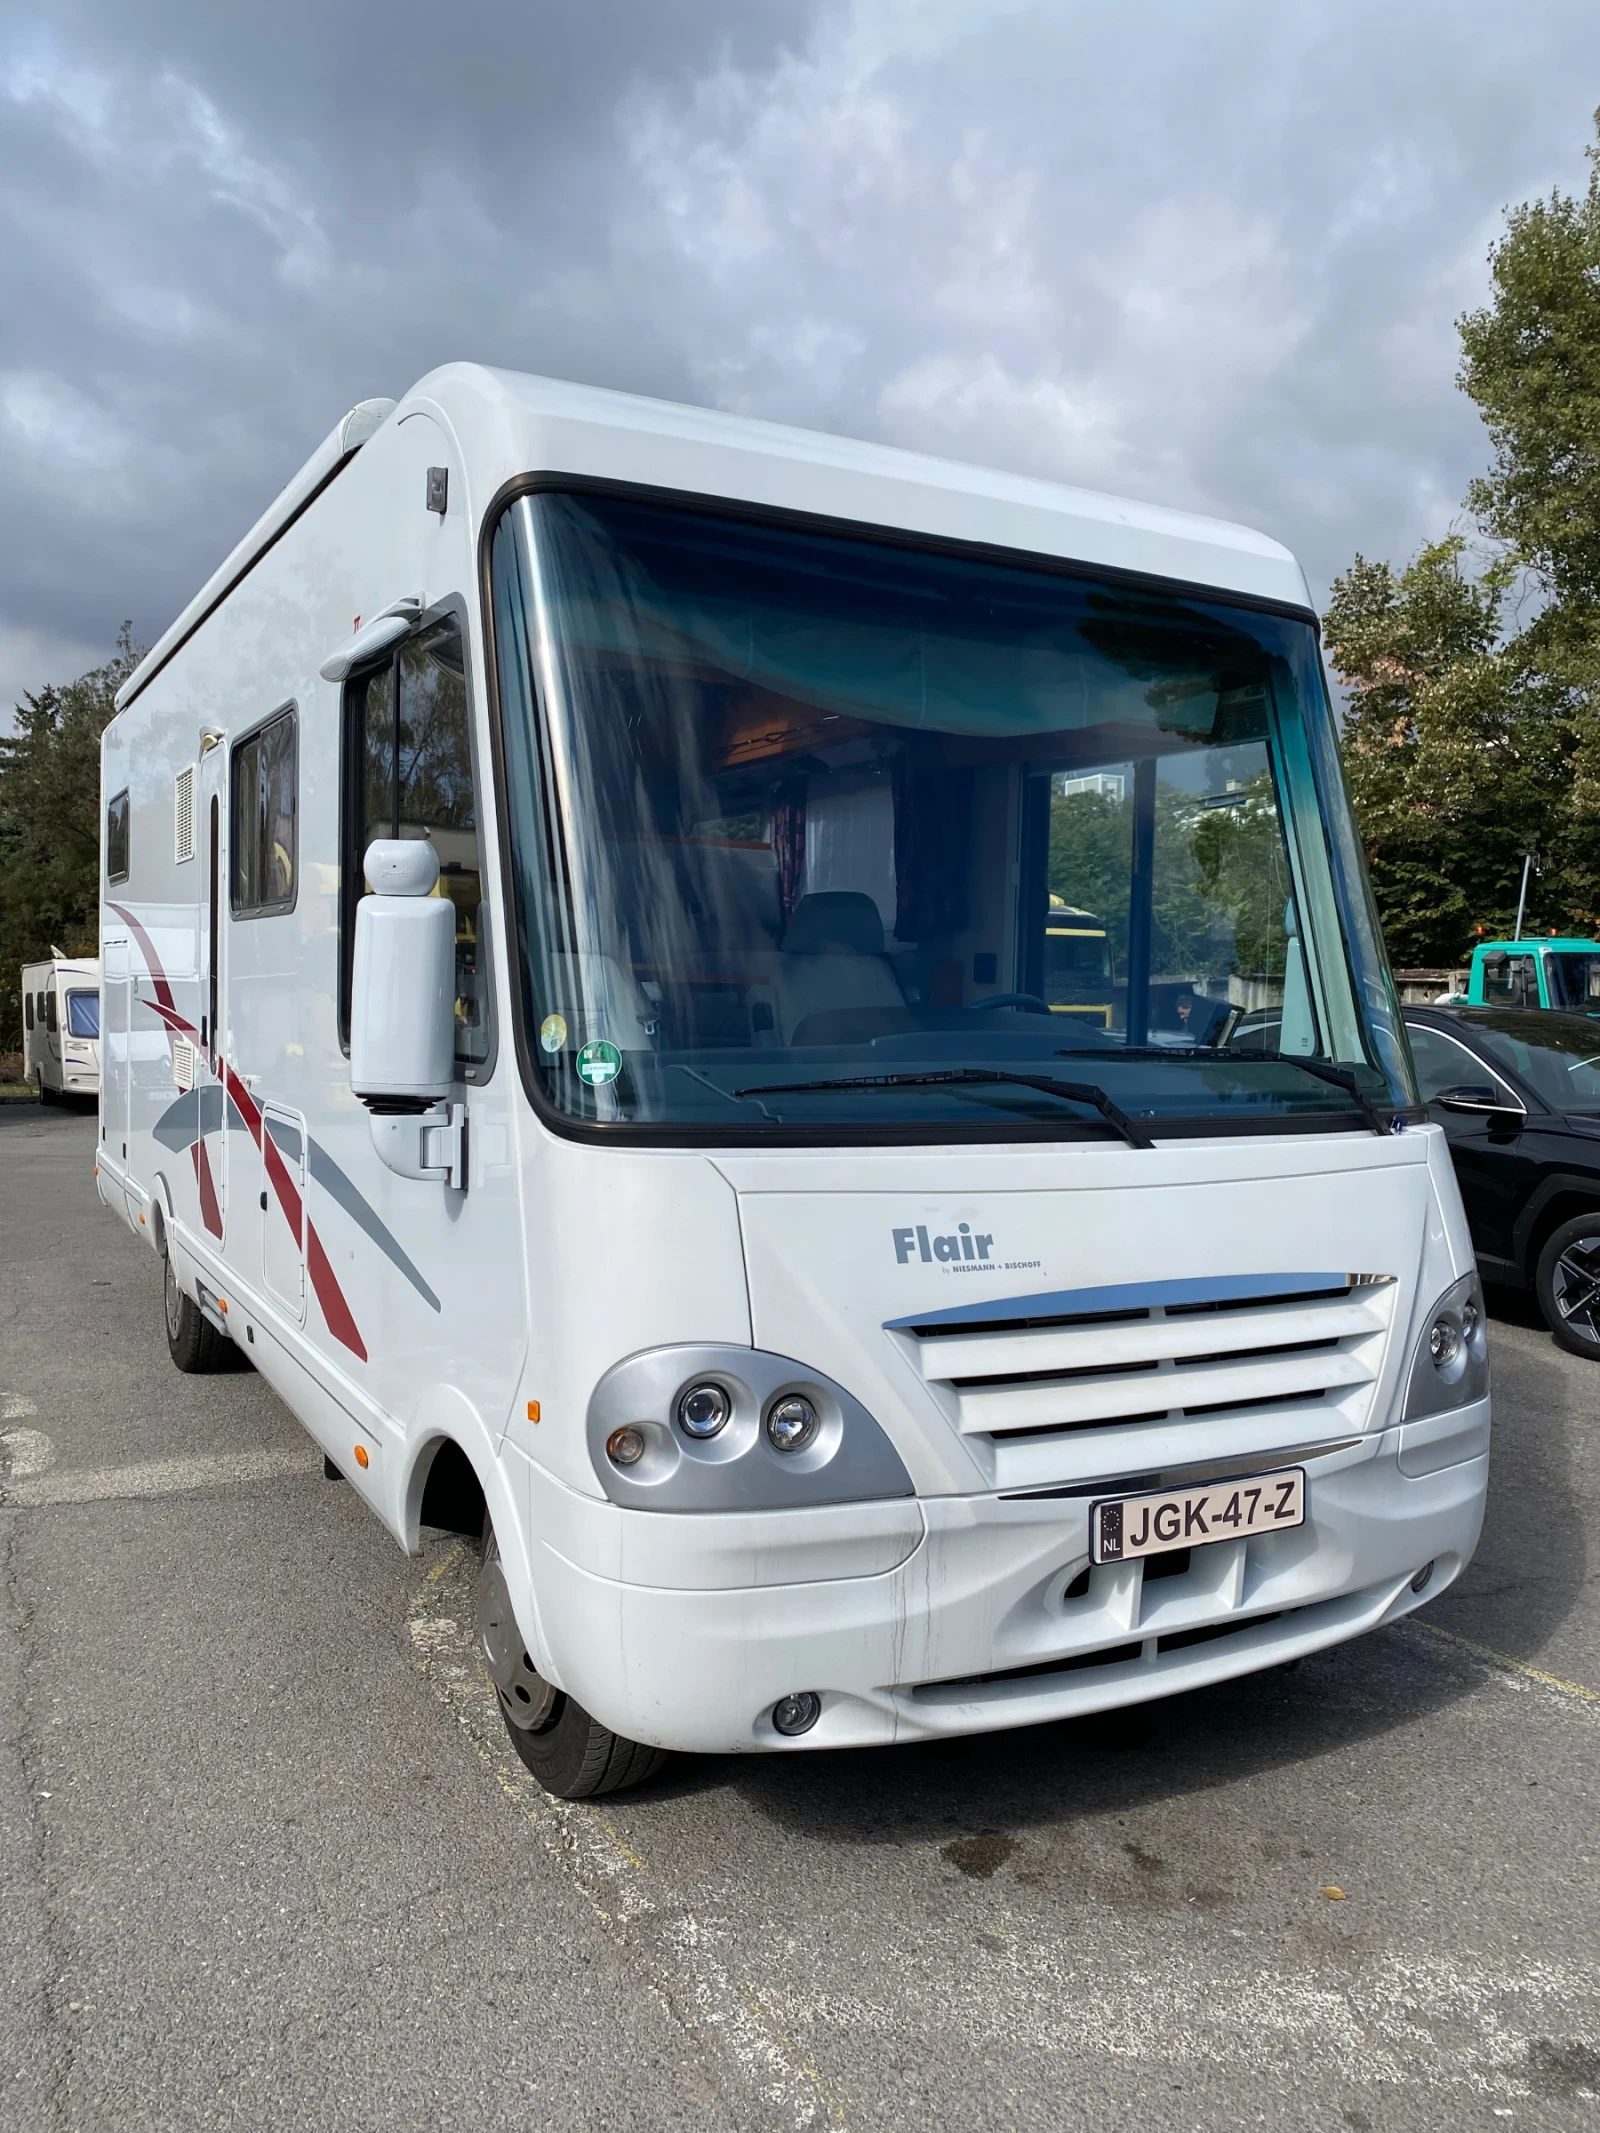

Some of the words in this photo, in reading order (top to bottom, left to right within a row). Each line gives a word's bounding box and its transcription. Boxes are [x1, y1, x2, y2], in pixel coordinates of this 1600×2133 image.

[892, 1222, 994, 1264] Flair
[942, 1266, 950, 1274] by
[952, 1264, 996, 1273] NIESMANN
[1004, 1261, 1042, 1270] BISCHOFF
[1129, 1481, 1296, 1547] JGK-47-Z
[1103, 1538, 1121, 1553] NL
